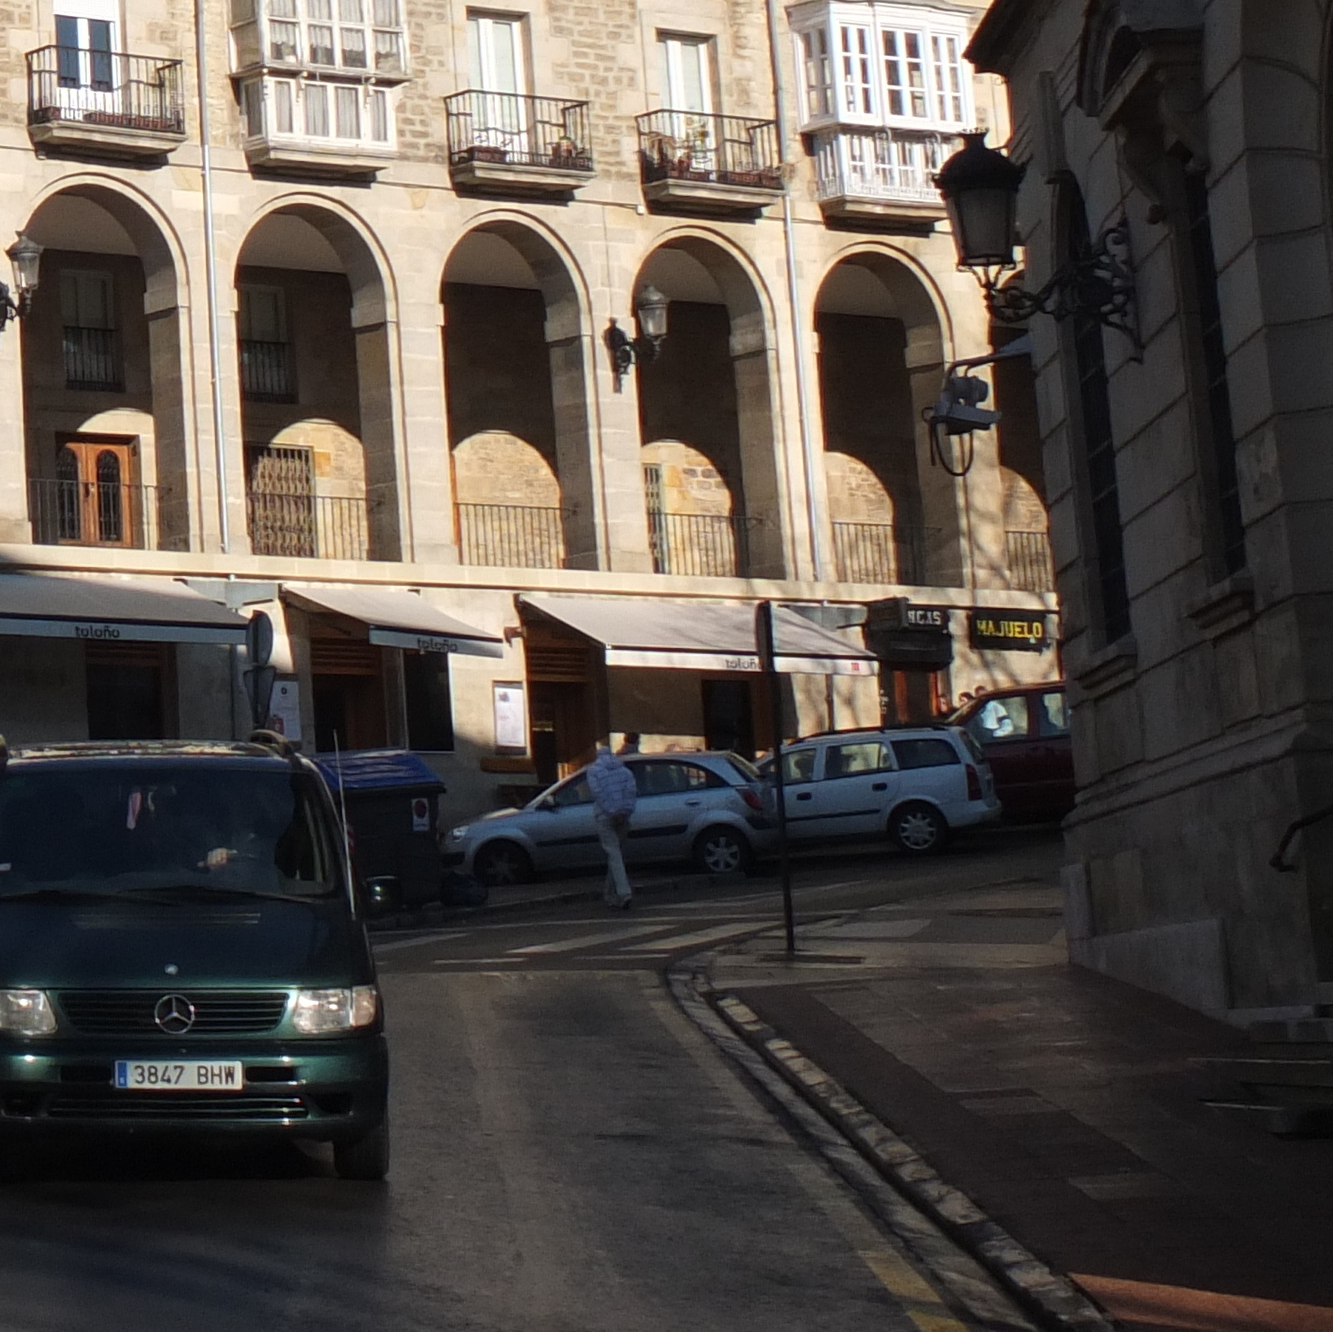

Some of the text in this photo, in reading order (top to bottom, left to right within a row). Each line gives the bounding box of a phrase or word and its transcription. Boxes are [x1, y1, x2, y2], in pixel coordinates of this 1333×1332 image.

[75, 624, 120, 638] toloño
[976, 620, 1042, 638] MAJUELO
[417, 637, 458, 653] toloño
[725, 657, 760, 670] toloñ
[134, 1065, 236, 1085] 3847 BHW
